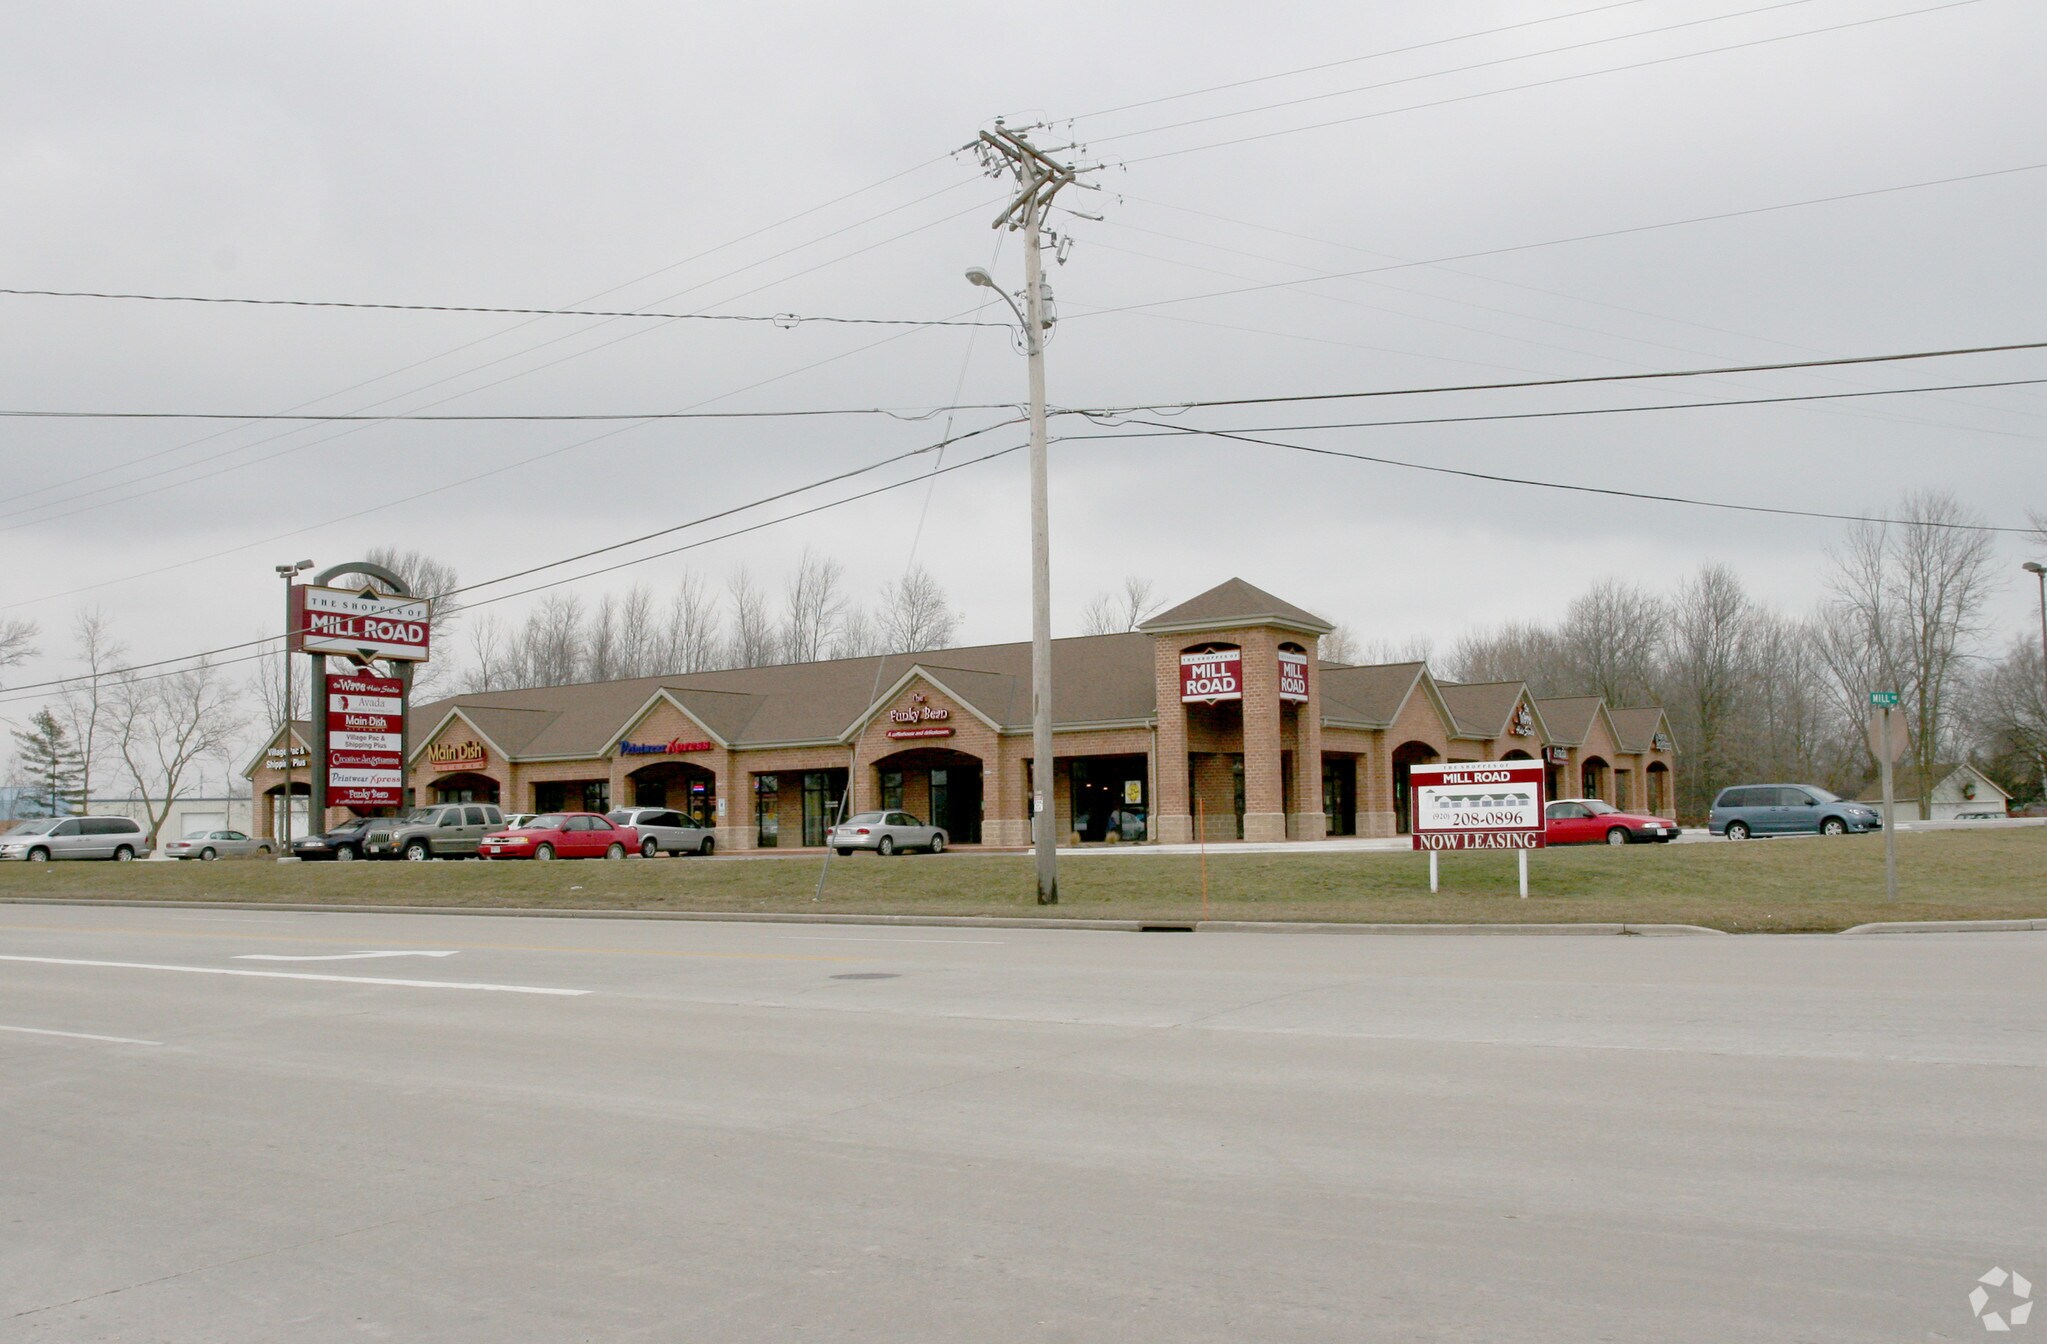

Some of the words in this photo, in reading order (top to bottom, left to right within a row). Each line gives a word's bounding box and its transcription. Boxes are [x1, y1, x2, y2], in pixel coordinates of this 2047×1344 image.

[311, 598, 337, 608] THE
[407, 609, 422, 617] OF
[310, 613, 360, 637] MILL
[364, 619, 424, 643] ROAD
[1192, 662, 1231, 679] MILL
[1283, 662, 1303, 679] MILL
[339, 678, 366, 692] Wave
[1186, 677, 1236, 695] ROAD
[1281, 677, 1305, 693] ROAD
[358, 697, 385, 708] Avada
[1872, 694, 1890, 703] MILL
[345, 714, 367, 726] Main
[369, 716, 387, 727] Dish
[889, 706, 921, 724] Funky
[923, 706, 949, 720] Bean
[345, 741, 373, 749] Shipping
[346, 734, 367, 742] Village
[428, 743, 457, 761] Main
[459, 741, 482, 759] Dish
[292, 758, 306, 767] Plus
[331, 772, 369, 784] Printwear
[370, 774, 401, 784] Xpress
[1443, 773, 1472, 784] MILL
[1474, 772, 1510, 783] ROAD
[349, 788, 370, 800] Funky
[371, 789, 389, 799] Bean
[1432, 813, 1450, 821] (920)
[1452, 811, 1523, 826] 208-0896
[1420, 834, 1460, 850] NOW
[1463, 832, 1537, 849] LEASING
